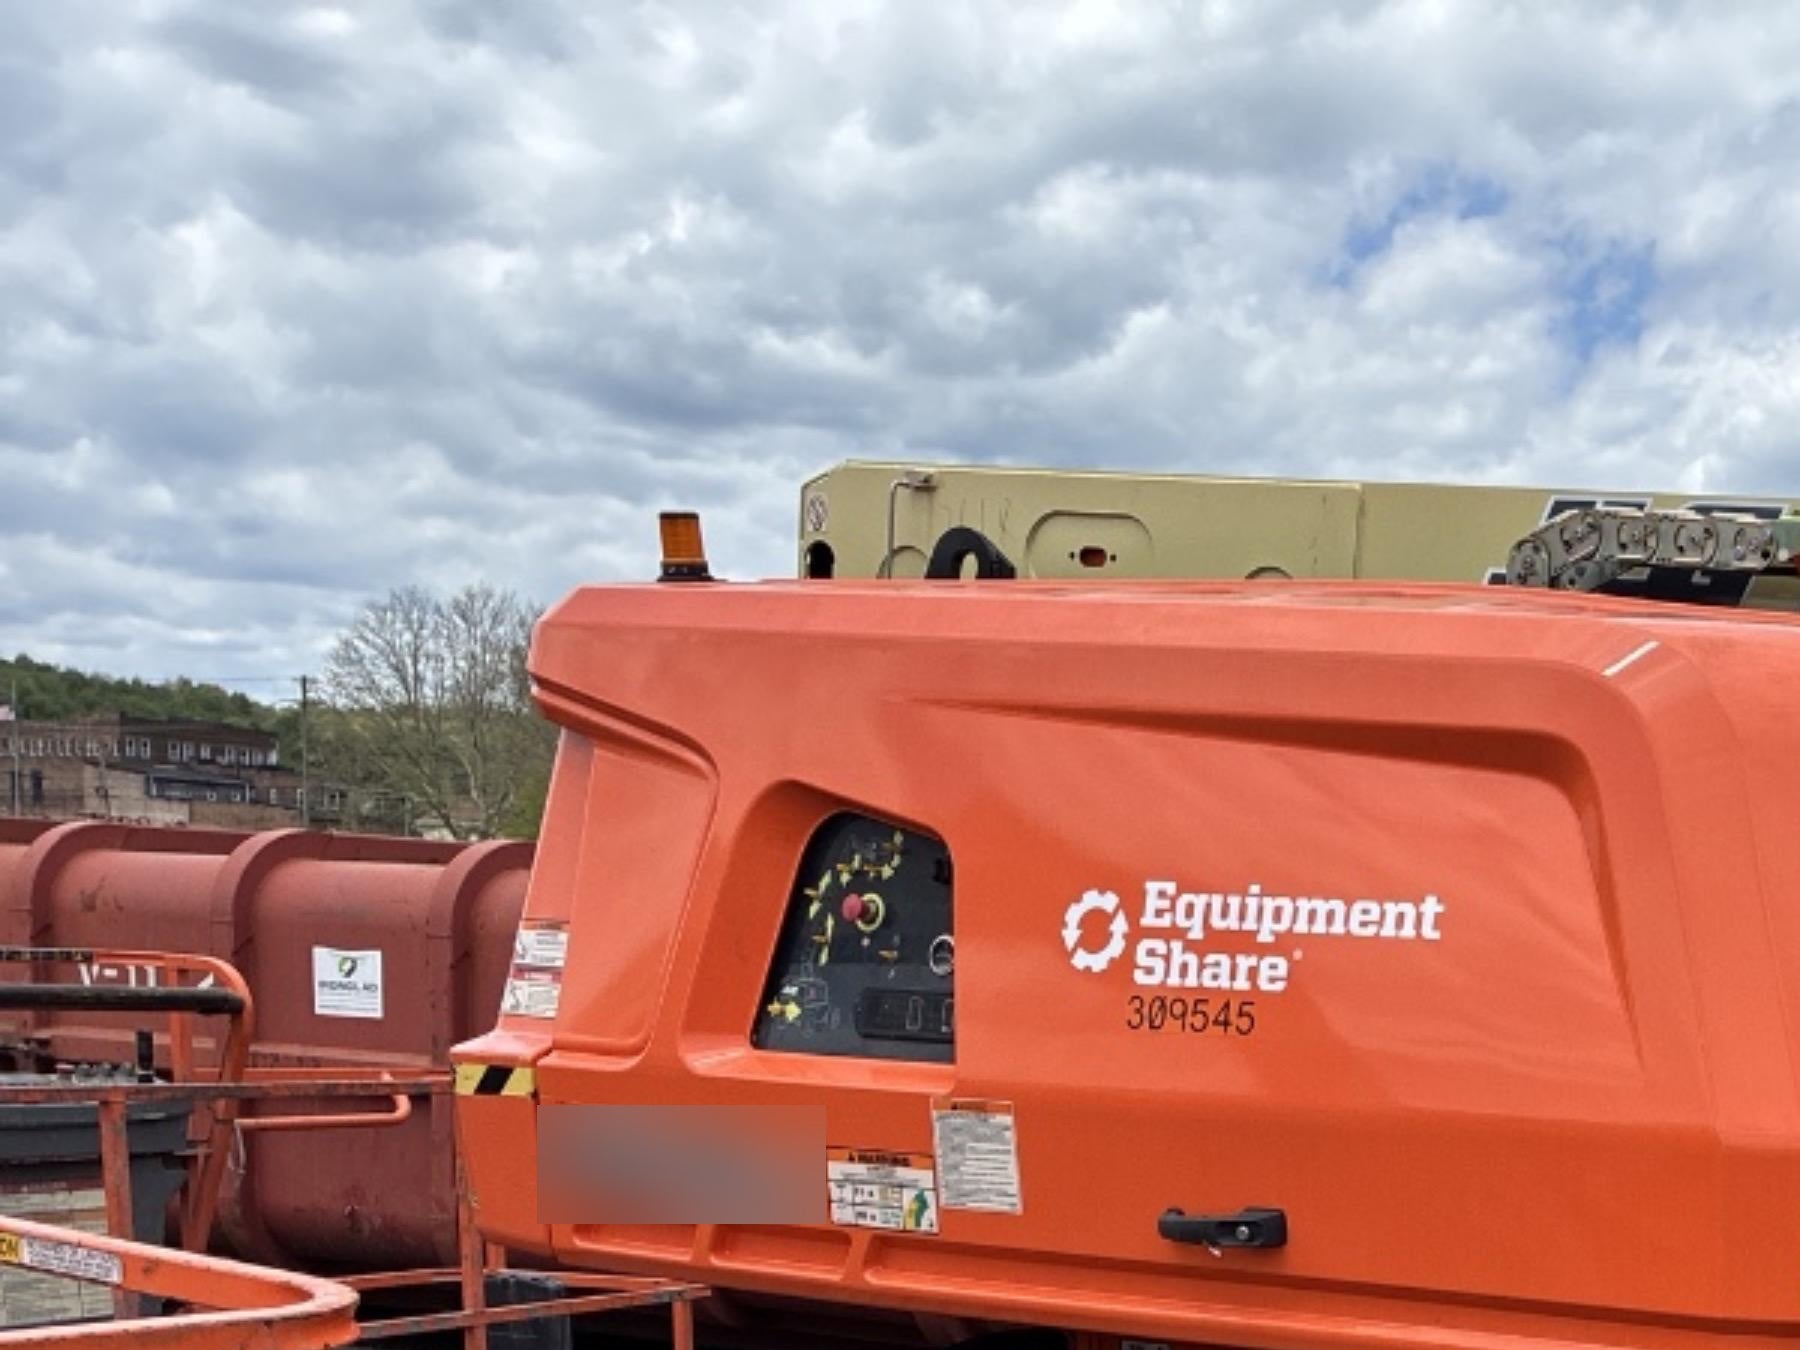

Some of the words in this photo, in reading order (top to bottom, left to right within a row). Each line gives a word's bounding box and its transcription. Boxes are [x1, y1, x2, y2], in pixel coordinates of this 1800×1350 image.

[1139, 880, 1445, 943] Equipment
[1132, 937, 1289, 992] Share
[1126, 995, 1256, 1036] 309545
